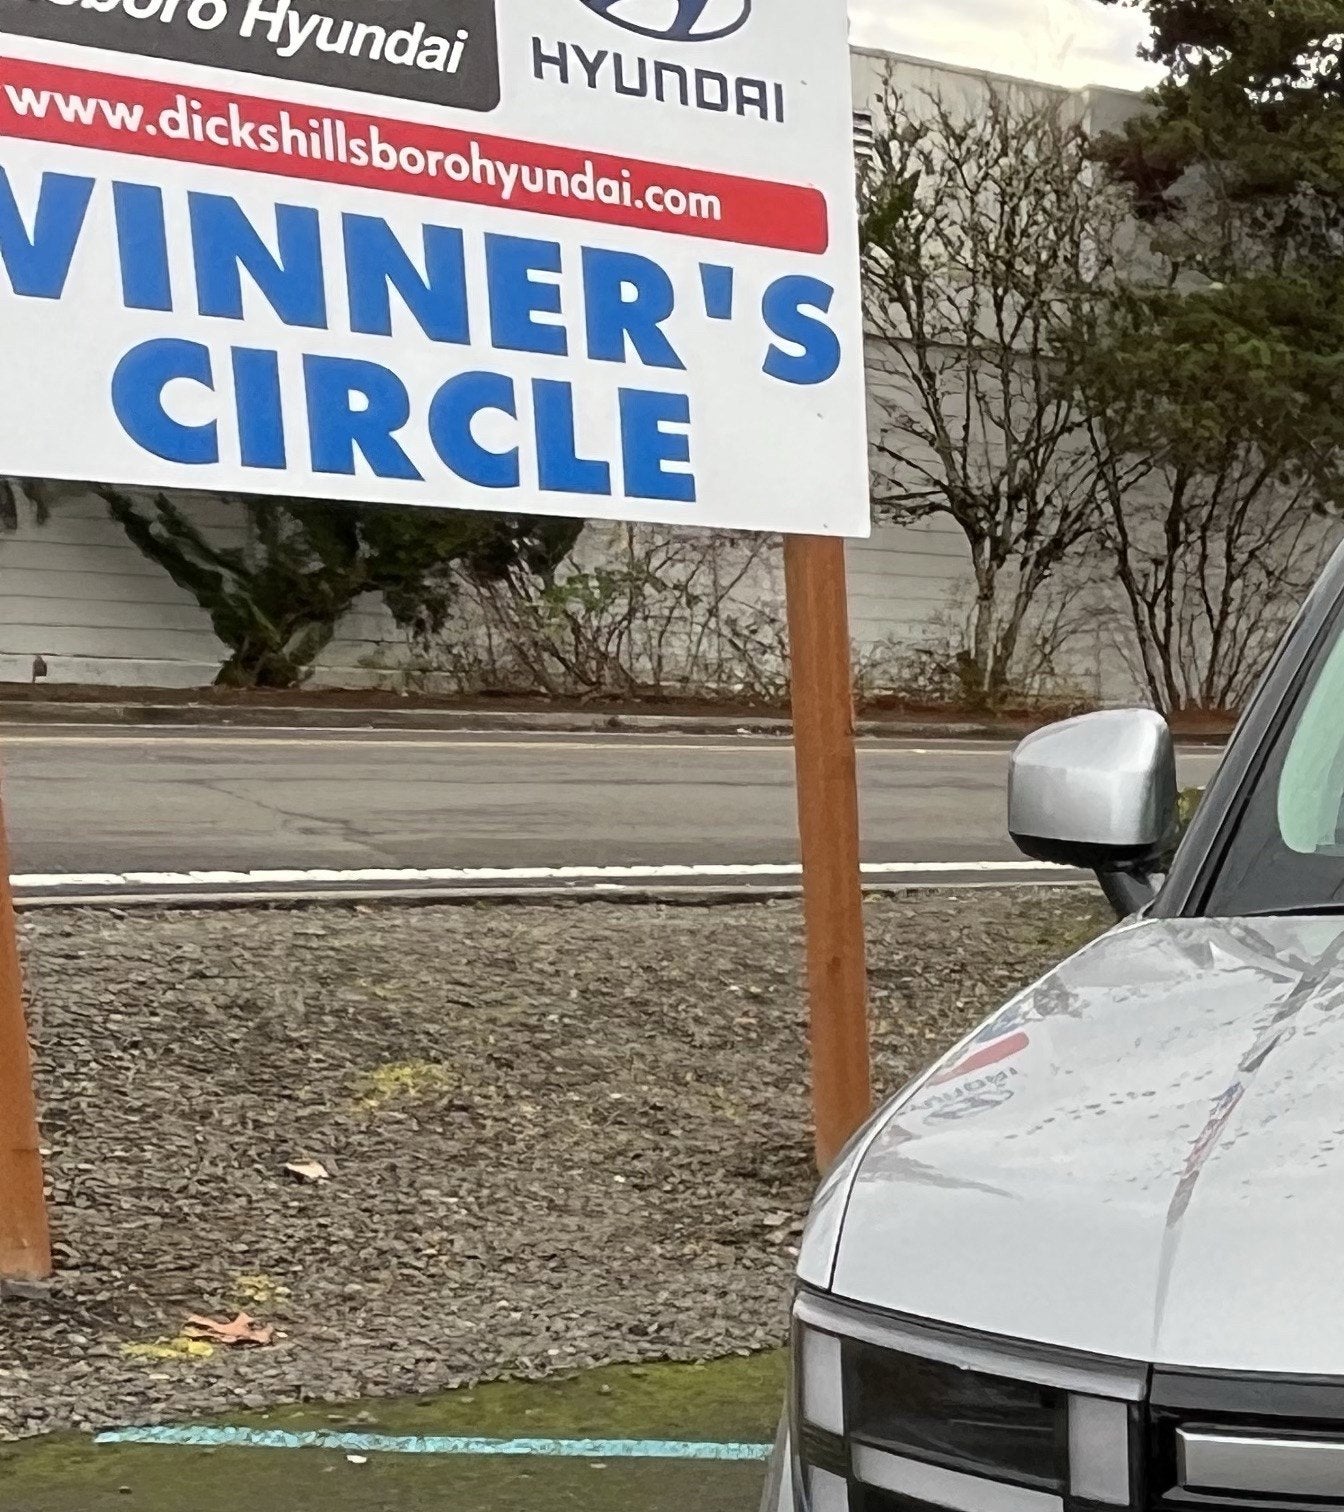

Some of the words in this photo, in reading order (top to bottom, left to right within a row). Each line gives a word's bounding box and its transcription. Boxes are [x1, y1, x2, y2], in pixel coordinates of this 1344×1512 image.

[48, 0, 228, 30] oro
[239, 0, 469, 75] Hyundai
[532, 37, 785, 123] HYUNDAI
[4, 84, 722, 221] www.dickshillsborohyundai.com
[111, 337, 697, 503] CIRCLE
